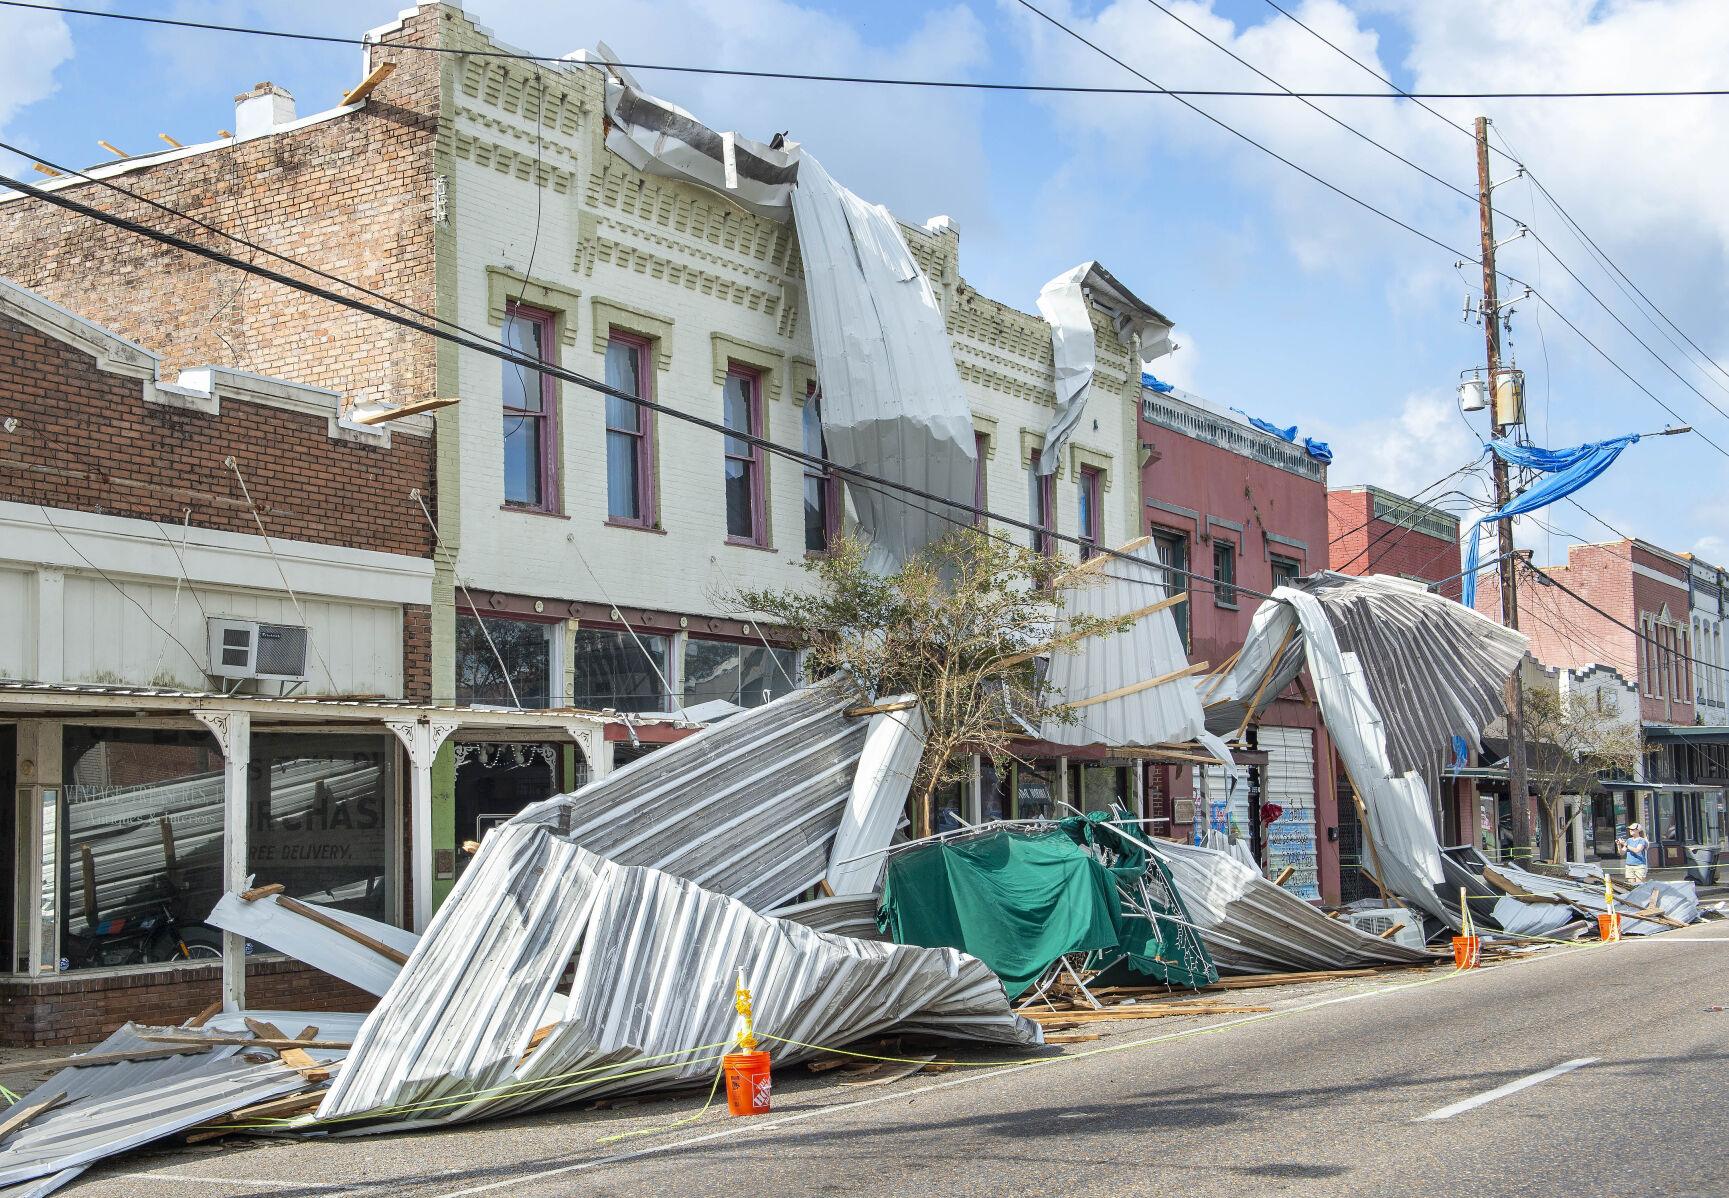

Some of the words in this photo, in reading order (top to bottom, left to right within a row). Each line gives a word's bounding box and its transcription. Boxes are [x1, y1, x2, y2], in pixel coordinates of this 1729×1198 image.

[64, 785, 123, 804] VINTAGE
[86, 811, 147, 828] Antiques
[164, 811, 216, 824] Interiors
[250, 844, 276, 860] REE
[281, 844, 352, 860] DELIVERY.
